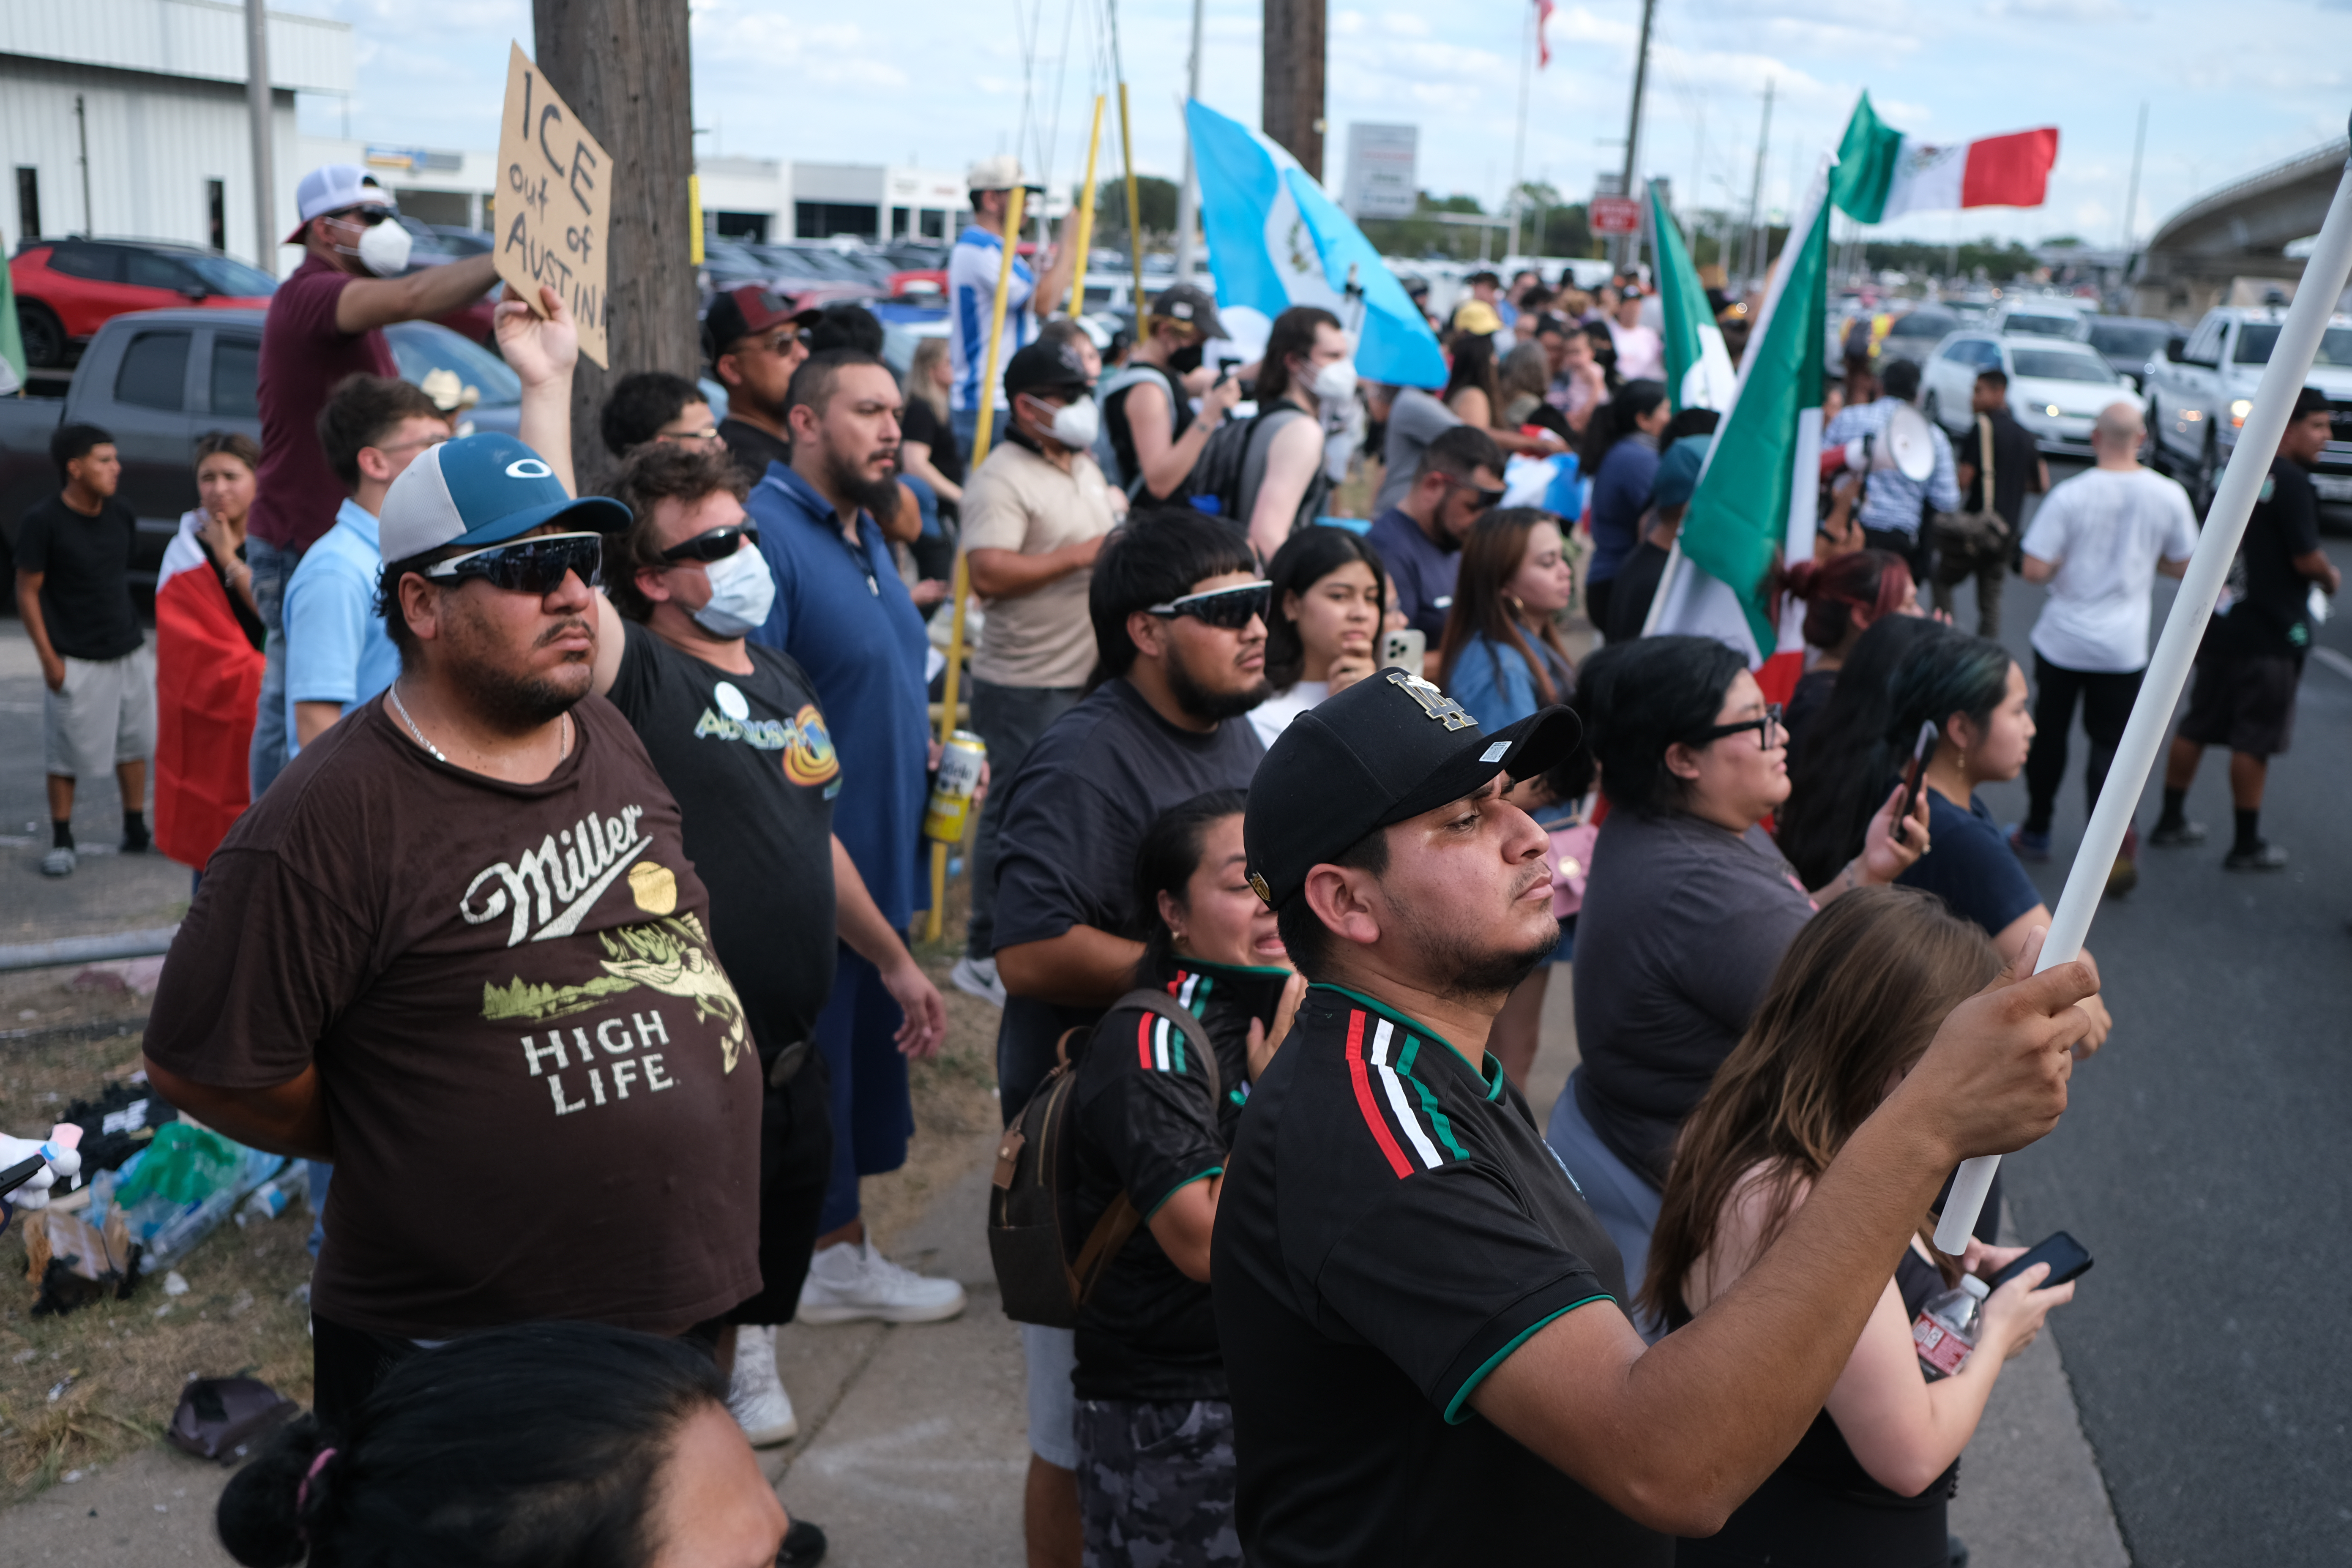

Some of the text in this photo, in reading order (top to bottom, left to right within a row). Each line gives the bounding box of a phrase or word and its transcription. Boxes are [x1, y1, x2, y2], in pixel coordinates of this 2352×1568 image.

[524, 71, 597, 216] ICE
[567, 224, 593, 264] of
[459, 804, 644, 948] Miller
[520, 1010, 670, 1076] HIGH
[547, 1054, 675, 1117] LIFE
